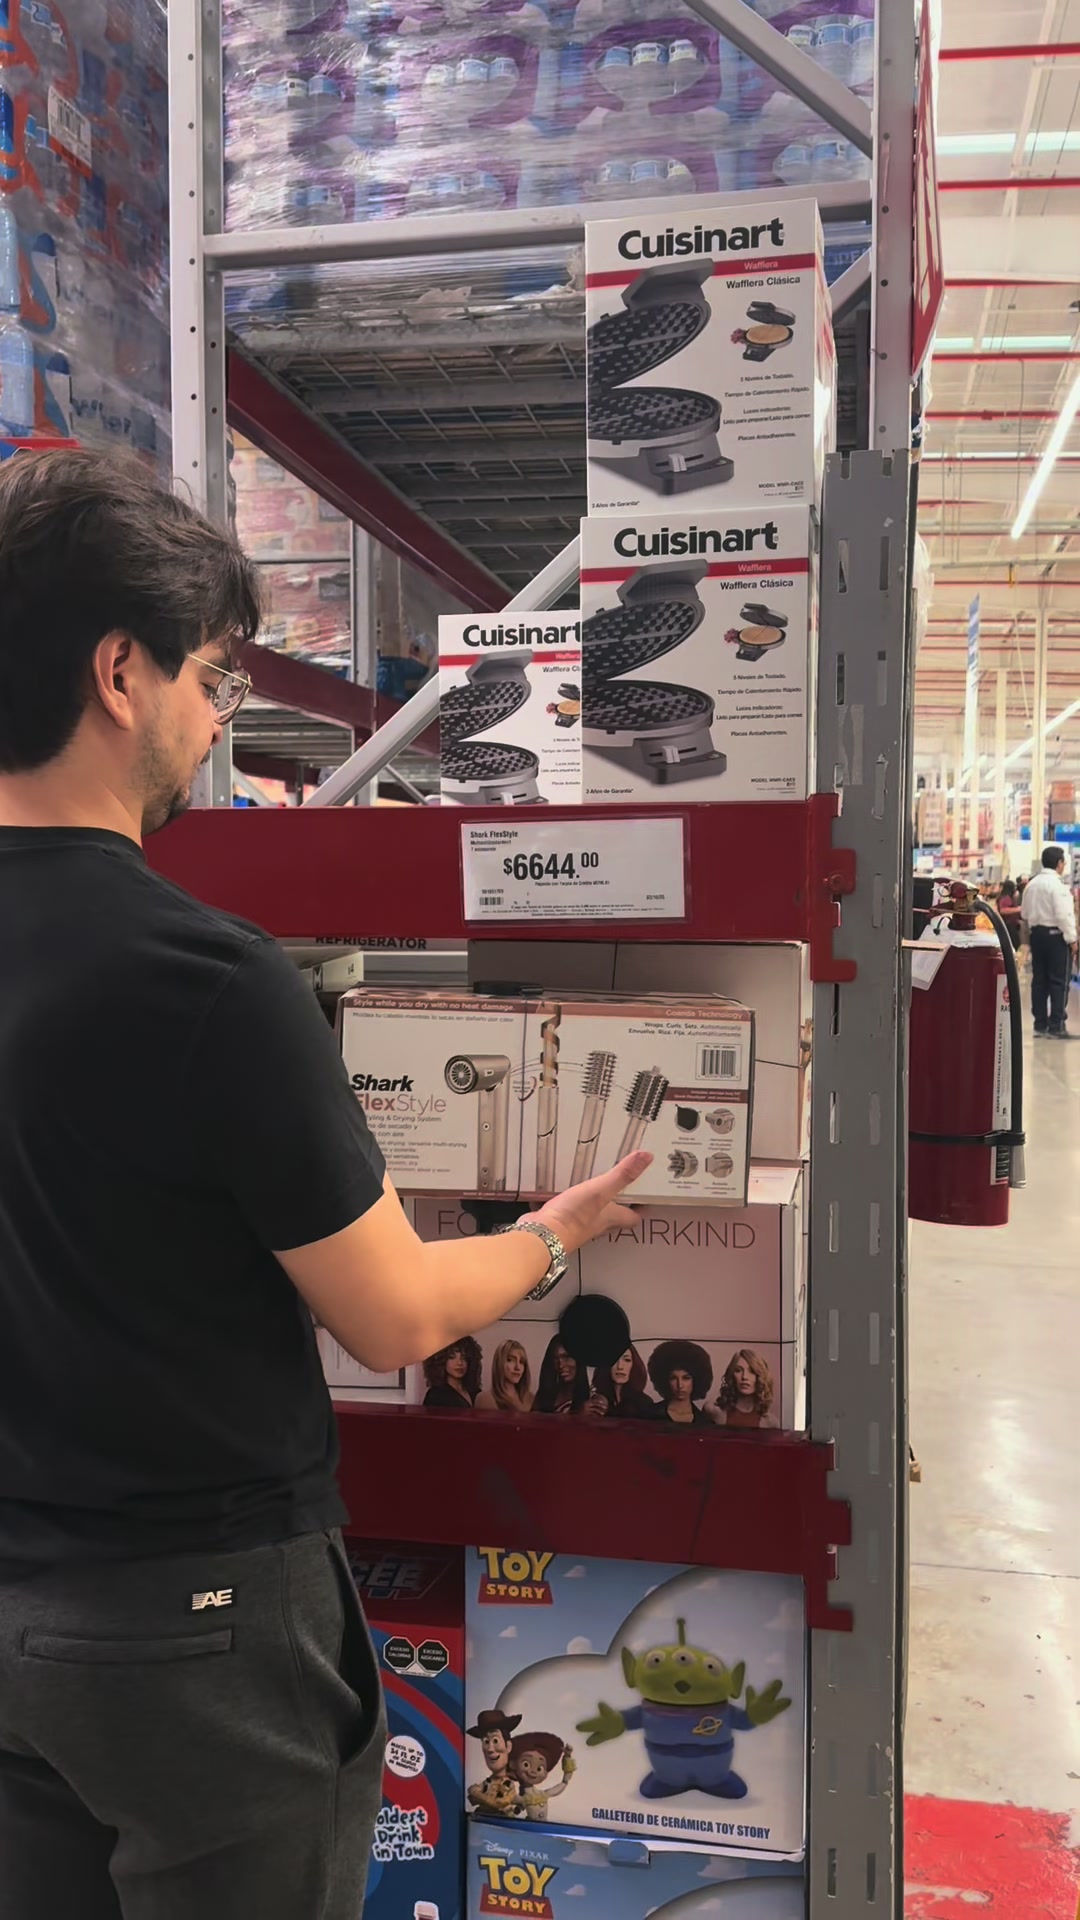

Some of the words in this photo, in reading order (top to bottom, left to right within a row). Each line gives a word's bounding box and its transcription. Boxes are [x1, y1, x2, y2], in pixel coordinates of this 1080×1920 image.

[618, 217, 784, 260] Cuisinart
[744, 261, 778, 270] Wafflera
[726, 279, 764, 289] Wafflera
[766, 276, 801, 285] Clásica
[613, 521, 778, 557] Cuisinart
[737, 563, 772, 572] Wafflera
[720, 581, 758, 590] Wafflera
[759, 579, 794, 588] Clásica
[463, 621, 581, 647] Cuisinart
[489, 830, 518, 839] FlexStyle
[353, 998, 374, 1007] Style
[414, 1001, 429, 1009] dry
[430, 1001, 448, 1009] with
[461, 1002, 480, 1010] heat
[665, 1009, 696, 1017] Coanda
[698, 1010, 742, 1020] Technology
[351, 1073, 415, 1092] Shark
[479, 1546, 554, 1582] TOY
[486, 1583, 546, 1600] STORY
[377, 1807, 426, 1825] oldest
[592, 1807, 645, 1824] GALLETERO
[646, 1814, 660, 1826] DE
[661, 1816, 714, 1833] CERÁMICA
[715, 1822, 735, 1835] TOY
[736, 1825, 771, 1840] STORY
[377, 1825, 421, 1843] Drink
[375, 1845, 390, 1858] in
[393, 1843, 432, 1858] Town
[483, 1839, 514, 1858] Disney
[520, 1848, 549, 1860] PIXAR
[480, 1856, 555, 1897] TOY
[487, 1893, 546, 1914] STORY
